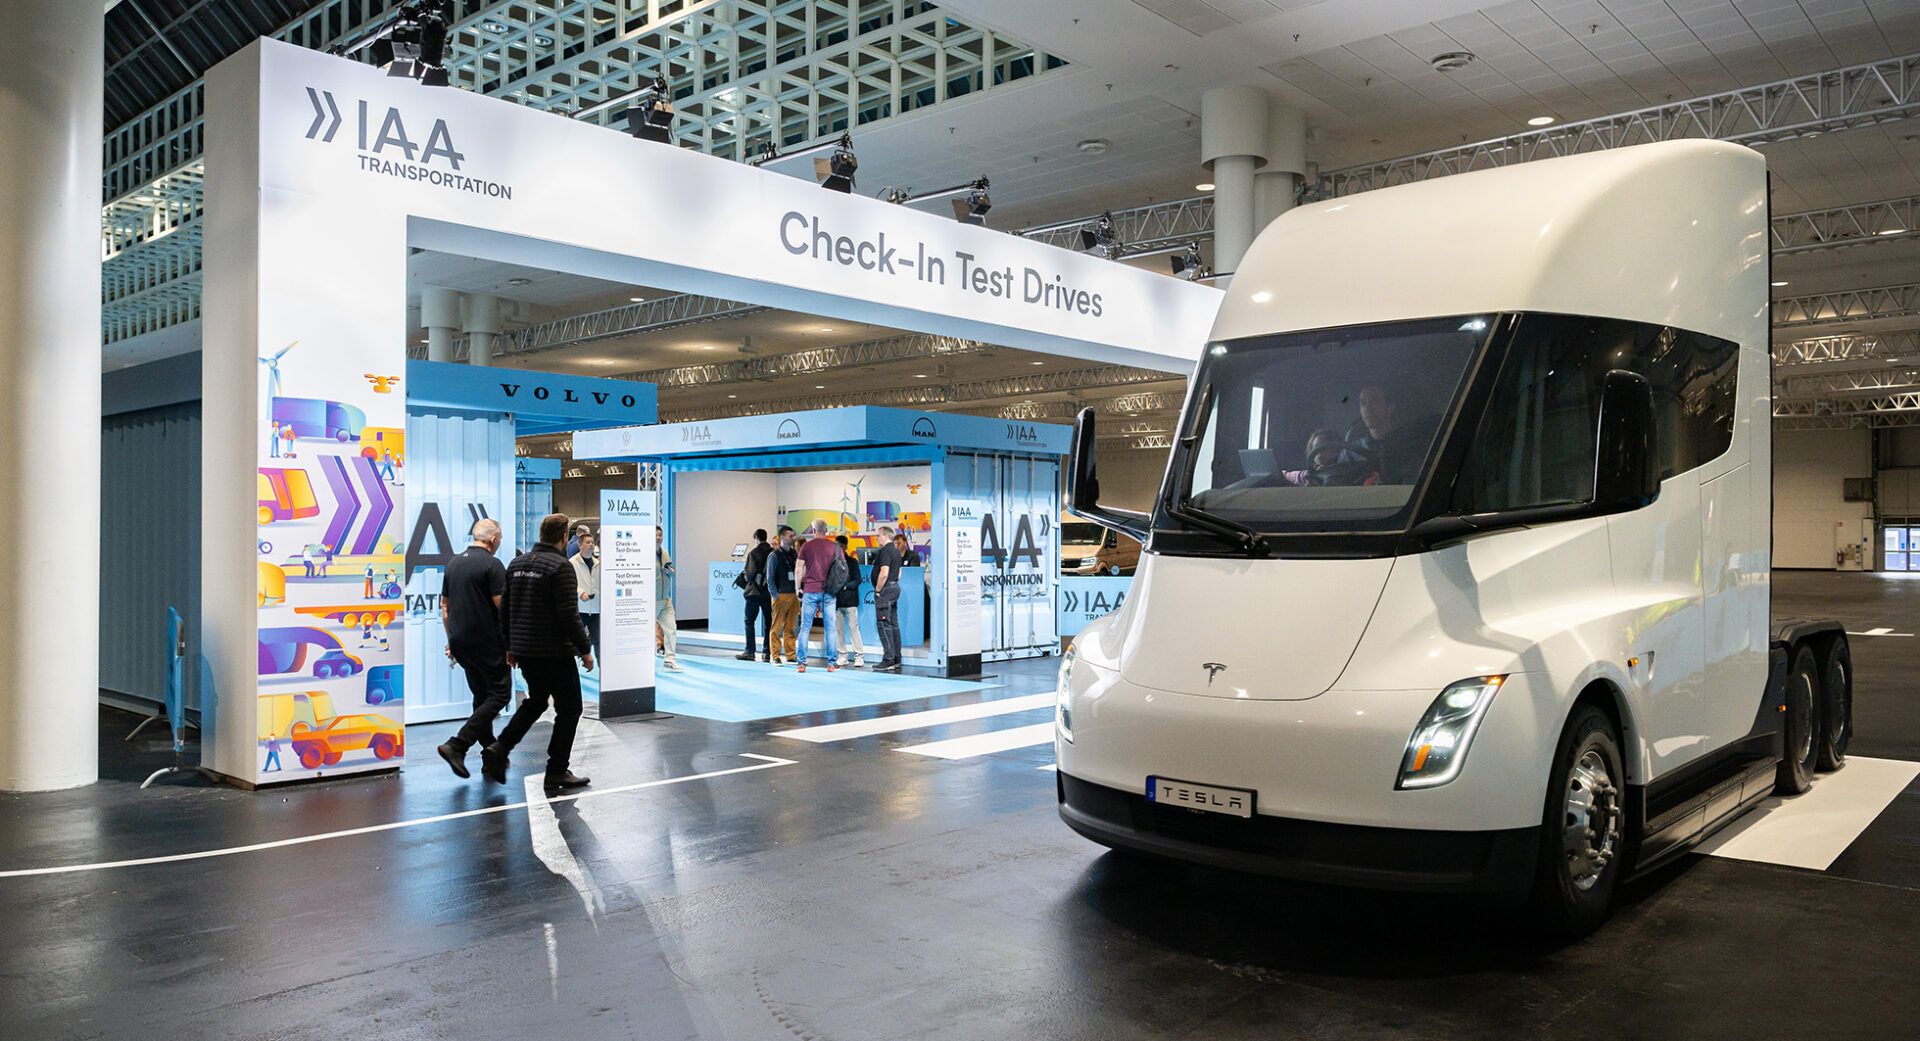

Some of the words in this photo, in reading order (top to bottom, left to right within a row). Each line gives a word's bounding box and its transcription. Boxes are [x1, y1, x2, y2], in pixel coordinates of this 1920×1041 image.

[359, 100, 465, 171] IAA
[358, 155, 511, 199] TRANSPORTATION
[955, 251, 1014, 299] Test
[1024, 267, 1102, 317] Drives
[500, 384, 635, 407] VOLVO
[691, 425, 711, 441] IAA
[1016, 425, 1037, 441] IAA
[617, 500, 640, 511] IAA
[957, 507, 971, 516] IAA
[981, 513, 1043, 569] AA
[981, 574, 1043, 586] NSPORTATION
[405, 594, 442, 611] TATI
[1163, 787, 1241, 809] TESLA
